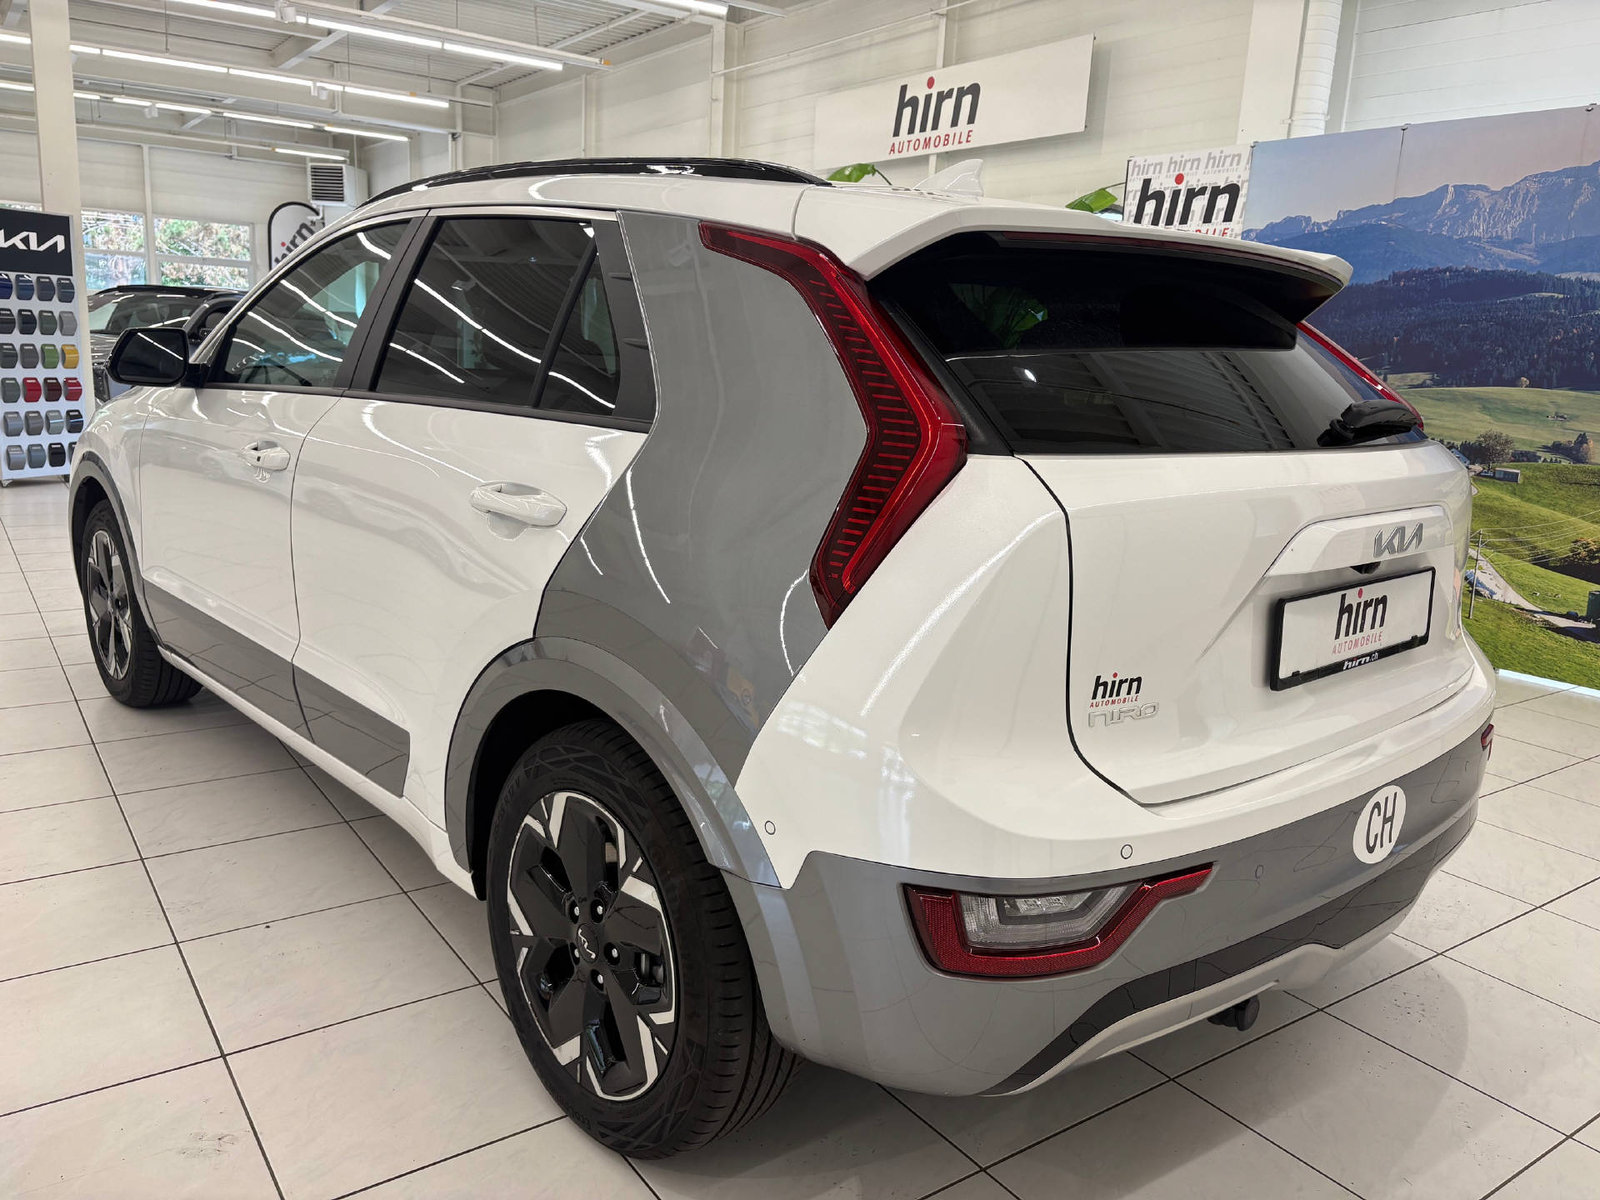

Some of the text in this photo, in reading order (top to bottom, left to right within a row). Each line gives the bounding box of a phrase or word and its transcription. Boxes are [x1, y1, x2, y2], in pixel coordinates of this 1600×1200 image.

[892, 76, 981, 138] hirn
[888, 129, 973, 155] AUTOMOBILE
[1130, 159, 1163, 177] hirn
[1167, 155, 1201, 174] hirn
[1204, 149, 1242, 169] hirn
[1133, 173, 1241, 227] hirn
[1334, 587, 1388, 641] hirn
[1332, 630, 1384, 655] AUTOMOBILE
[1343, 652, 1379, 670] hirn.ch
[1091, 672, 1143, 700] hirn
[1089, 694, 1139, 709] AUTOMOBILE
[1365, 791, 1398, 854] CH
